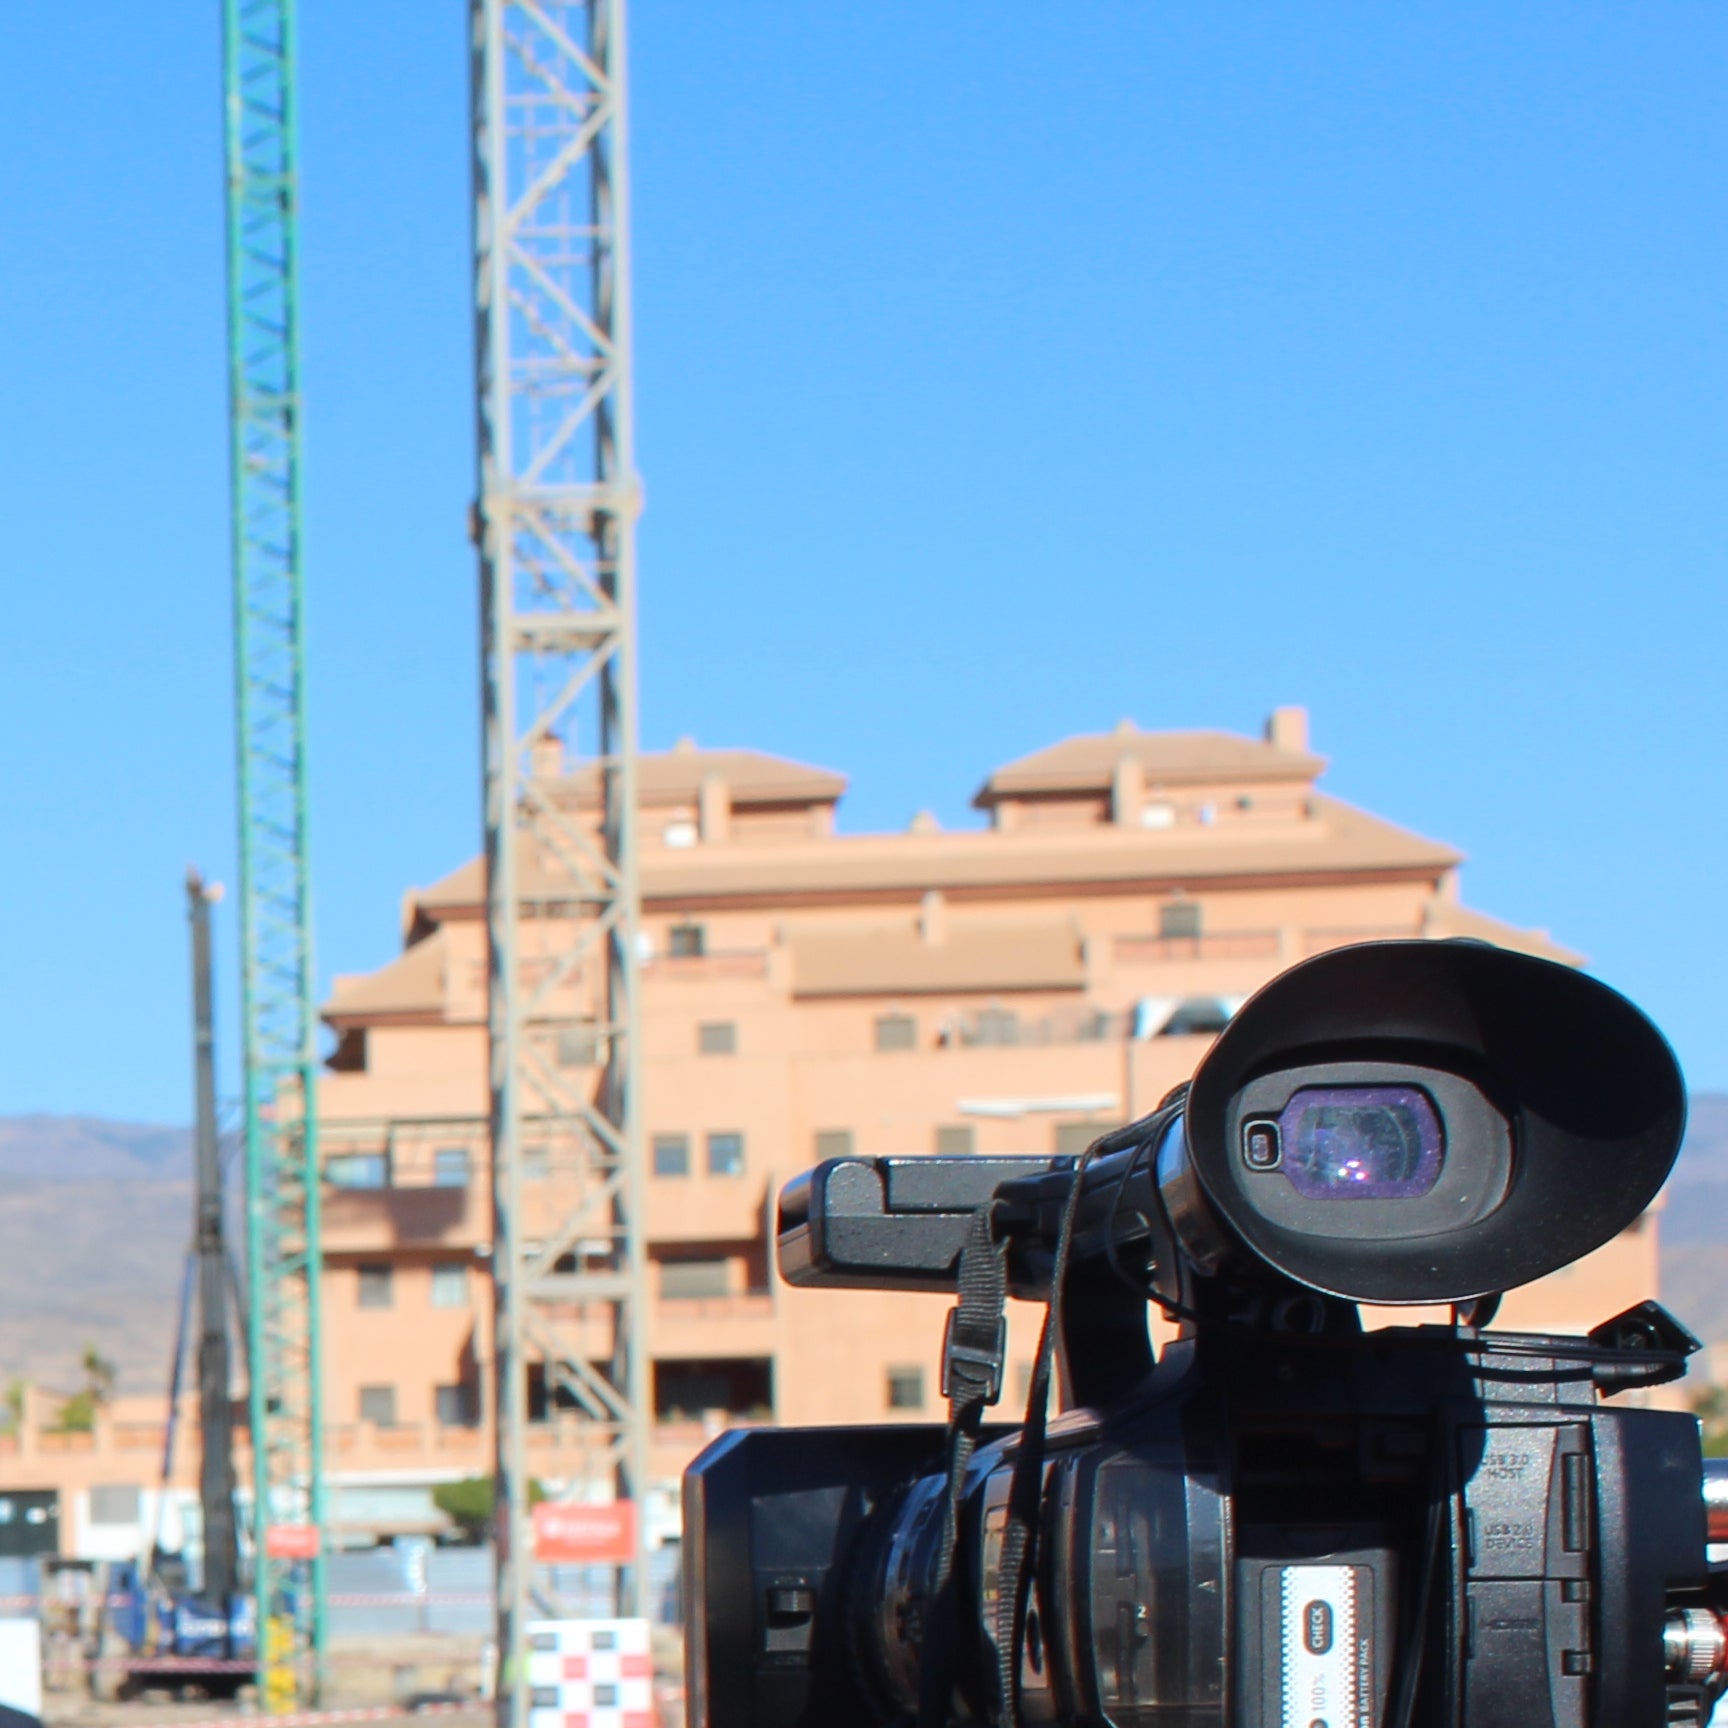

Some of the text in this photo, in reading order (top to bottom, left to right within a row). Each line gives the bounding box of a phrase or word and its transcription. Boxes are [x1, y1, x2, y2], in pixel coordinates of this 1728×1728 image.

[1487, 1467, 1523, 1480] HOST
[1484, 1524, 1533, 1536] USB 2.0
[1485, 1537, 1534, 1549] DEVICE
[1137, 1606, 1148, 1618] 2
[1311, 1606, 1324, 1649] CHECK
[1359, 1637, 1370, 1668] PACK
[1310, 1672, 1326, 1712] 100%
[1359, 1668, 1370, 1712] BATTERY
